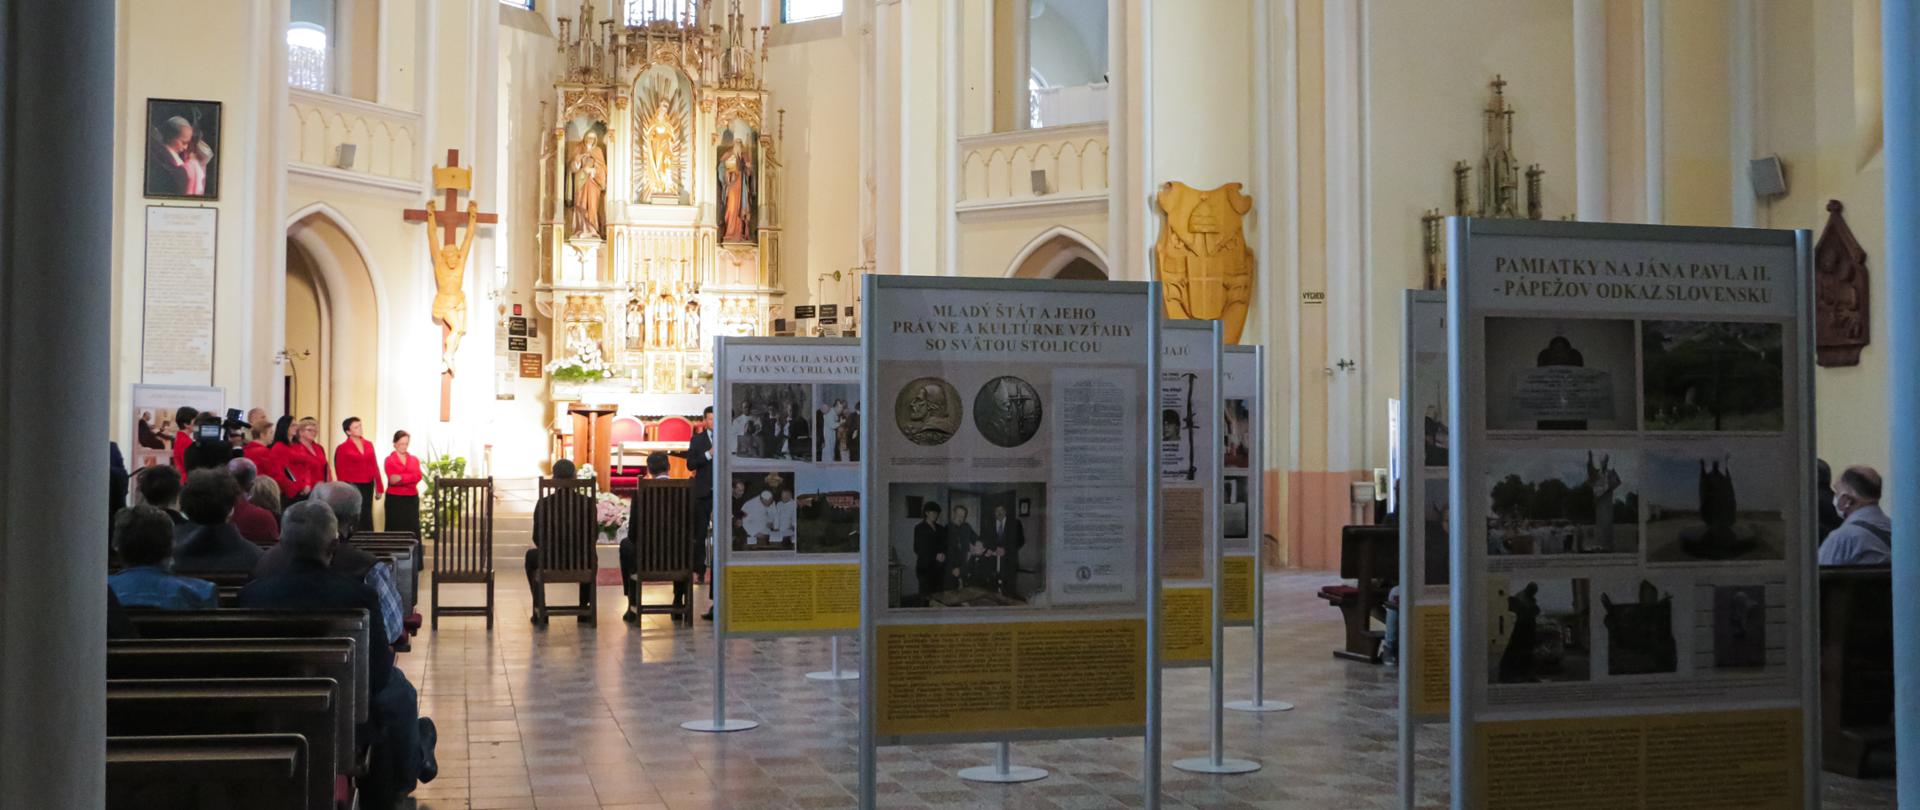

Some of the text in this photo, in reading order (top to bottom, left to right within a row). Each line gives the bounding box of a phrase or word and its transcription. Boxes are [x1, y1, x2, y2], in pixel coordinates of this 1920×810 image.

[1496, 257, 1772, 282] PAMIATKY NA JÁNA PAVLA II.
[1504, 277, 1595, 298] PÁPEŽOV
[1598, 281, 1662, 300] ODKAZ
[1666, 284, 1774, 303] SLOVENSKU
[933, 303, 1096, 320] MLADÝ ŠTÁT A JEHO
[893, 320, 1133, 337] PRÁVNE A KULTÚRNE VZŤAHY
[926, 338, 1102, 353] SO SVÄTOU STOLICOU
[764, 354, 799, 363] PAVOL
[815, 354, 821, 363] A
[792, 365, 833, 375] CYRILA
